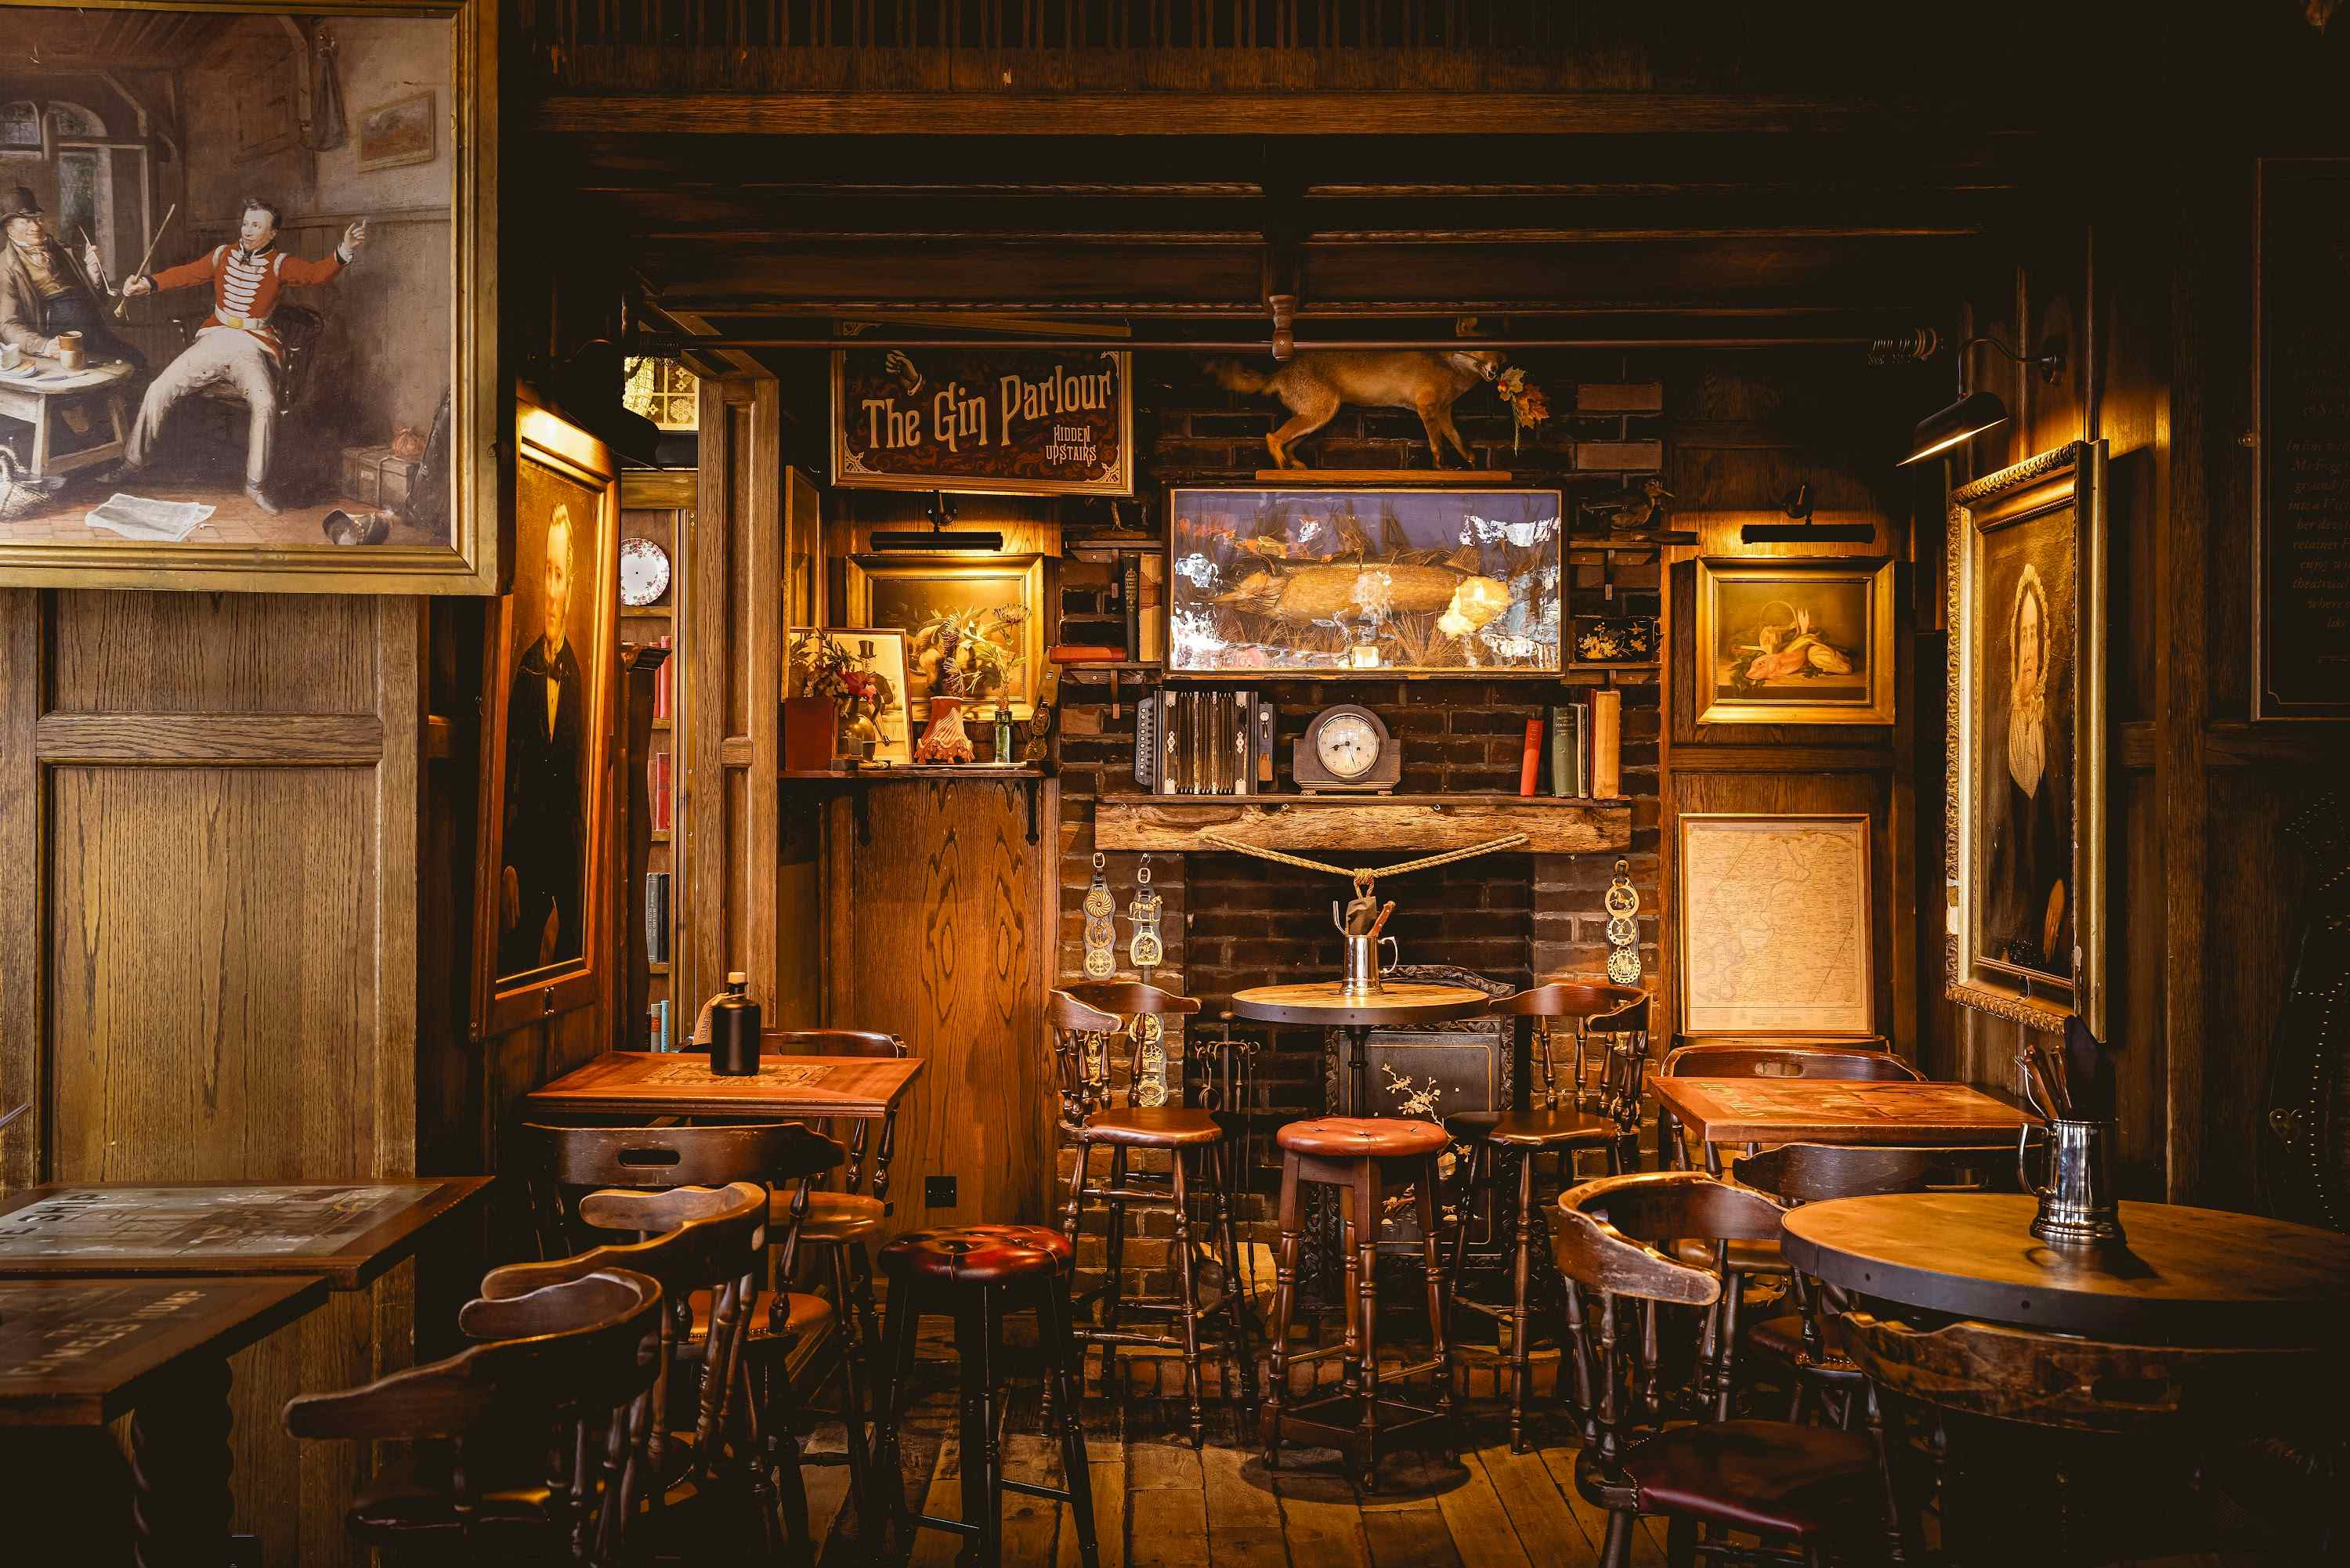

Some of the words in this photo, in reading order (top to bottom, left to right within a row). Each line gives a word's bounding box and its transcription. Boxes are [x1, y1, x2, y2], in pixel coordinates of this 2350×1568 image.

[862, 398, 921, 449] The
[934, 381, 989, 452] Gin
[1000, 365, 1111, 446] Parlour
[1054, 425, 1091, 444] HIDDEN
[1046, 443, 1097, 467] UPSTAIRS
[17, 1194, 107, 1222] SHIP
